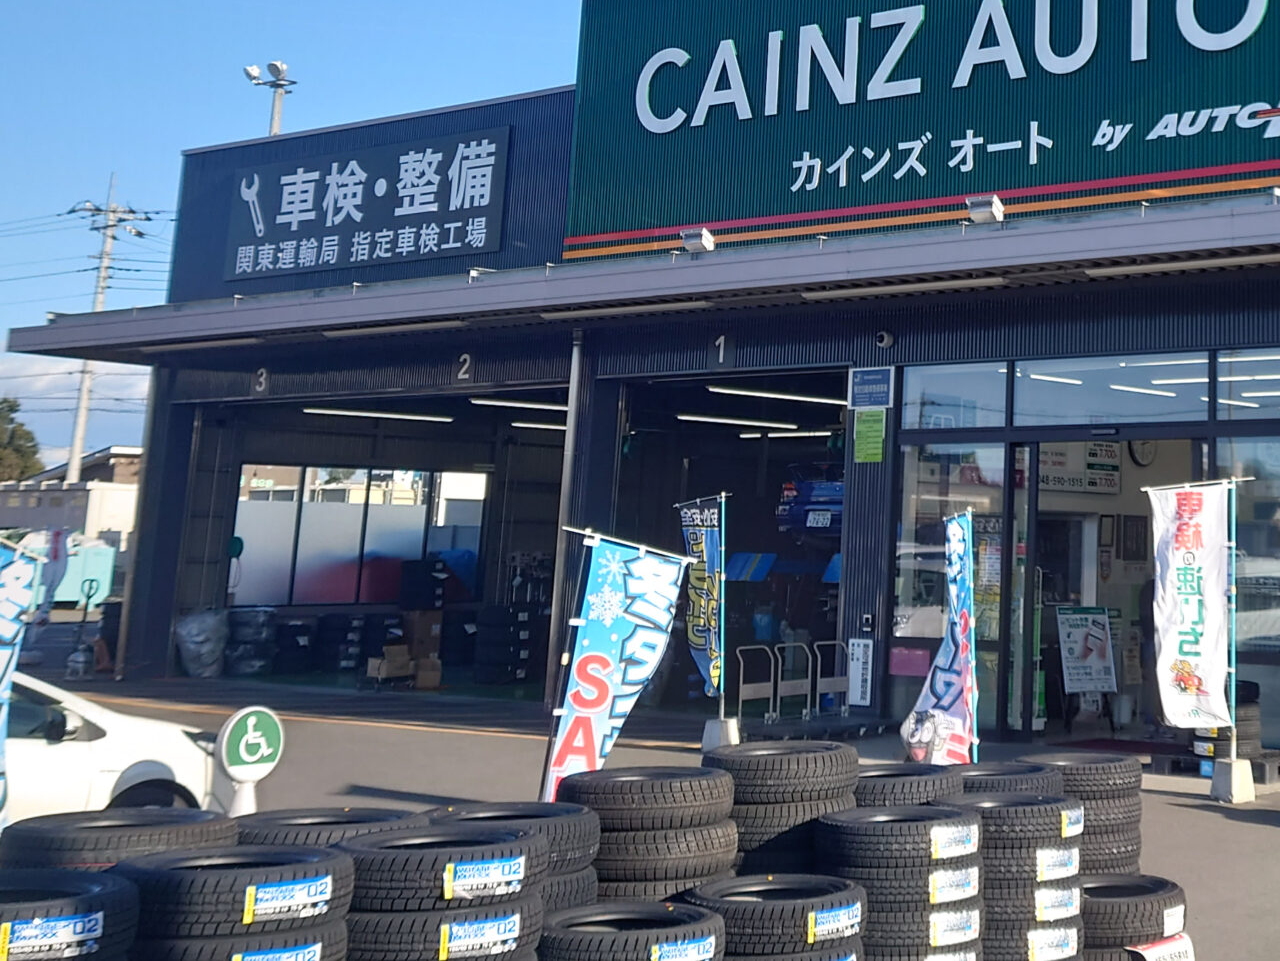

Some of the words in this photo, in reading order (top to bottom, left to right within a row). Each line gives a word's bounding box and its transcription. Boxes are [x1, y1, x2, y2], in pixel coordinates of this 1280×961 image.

[635, 4, 926, 133] CAINZ
[790, 132, 931, 192] カインズ
[948, 120, 1054, 174] オート
[1091, 119, 1133, 152] by
[275, 138, 497, 232] 車検・整備
[235, 234, 340, 274] 関東運輸局
[350, 216, 487, 263] 指定車検工場
[458, 354, 471, 380] 2
[715, 335, 725, 364] 1
[255, 368, 267, 392] 3
[550, 652, 614, 797] SA
